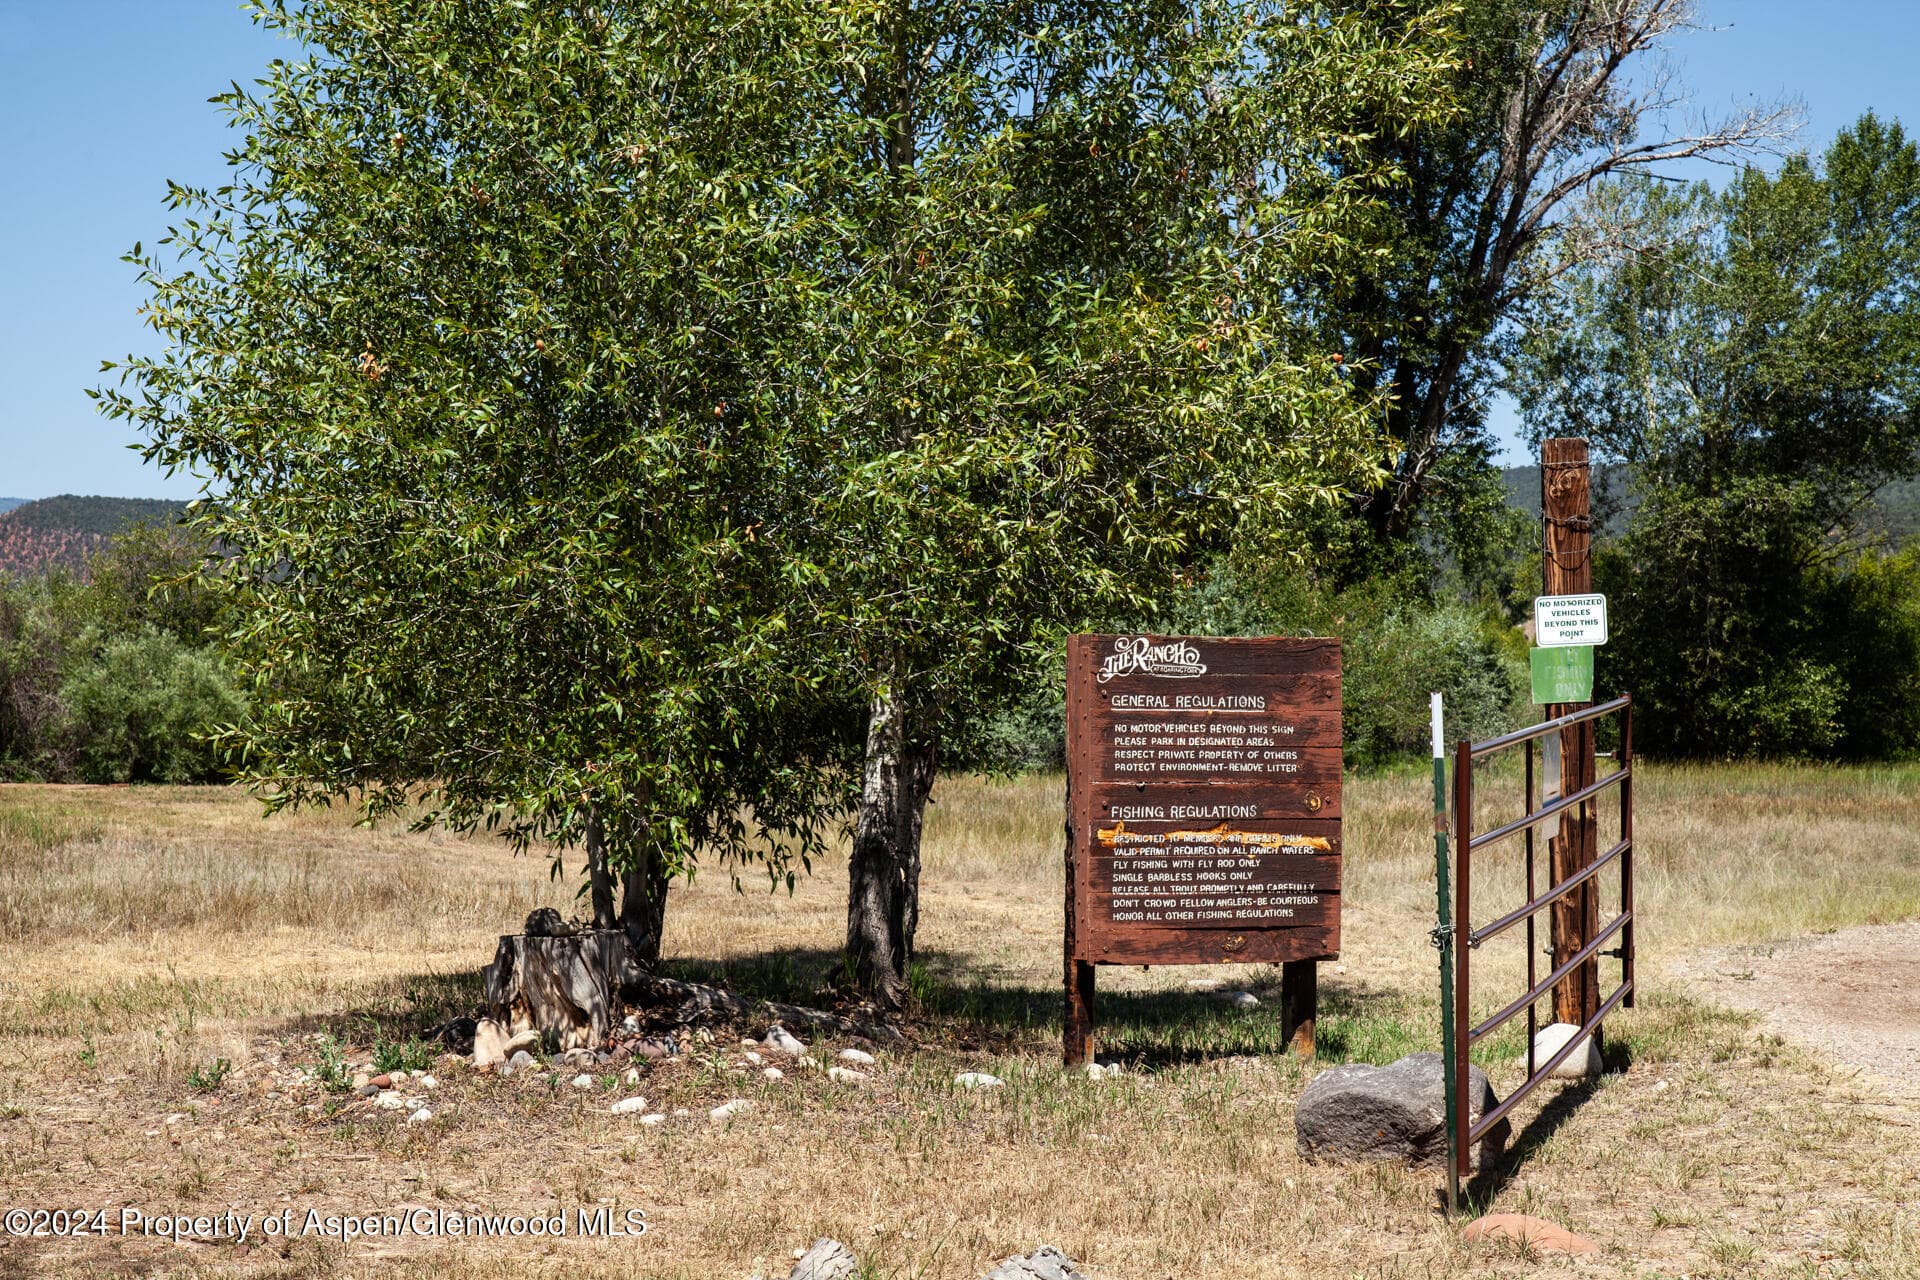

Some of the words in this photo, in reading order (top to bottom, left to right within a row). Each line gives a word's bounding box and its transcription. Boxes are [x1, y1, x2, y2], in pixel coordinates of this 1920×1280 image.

[1097, 649, 1133, 683] THE
[1112, 695, 1169, 707] GENERAL
[1176, 695, 1265, 708] REGULATIONS
[1115, 724, 1127, 732] NO
[1131, 724, 1160, 732] MOTOR
[1164, 724, 1206, 733] VEHICLES
[1210, 724, 1246, 733] BEYOND
[1249, 725, 1268, 734] THIS
[1272, 725, 1294, 734] SIGN
[1115, 737, 1147, 745] PLEASE
[1152, 737, 1173, 745] PARK
[1177, 737, 1185, 745] IN
[1189, 737, 1243, 746] DESIGNATED
[1246, 738, 1274, 746] AREAS
[1115, 750, 1155, 758] RESPECT
[1158, 750, 1195, 759] PRIVATE
[1199, 750, 1244, 759] PROPERTY
[1248, 750, 1260, 759] OF
[1264, 750, 1297, 760] OTHERS
[1115, 763, 1155, 771] PROTECT
[1268, 763, 1297, 772] LITTER
[1111, 806, 1164, 818] FISHING
[1171, 805, 1257, 818] REGULATIONS
[1173, 846, 1215, 855] REQUIRED
[1217, 846, 1229, 855] ON
[1233, 846, 1247, 855] ALL
[1250, 846, 1278, 855] RANCH
[1281, 846, 1314, 855] WATERS
[1114, 860, 1128, 869] FLY
[1133, 860, 1167, 869] FISHING
[1173, 860, 1194, 868] WITH
[1198, 860, 1214, 868] FLY
[1217, 859, 1235, 868] ROD
[1239, 859, 1261, 867] ONLY
[1113, 873, 1143, 881] SINGLE
[1148, 872, 1192, 881] BARBLESS
[1196, 872, 1226, 881] HOOKS
[1230, 872, 1252, 880] ONLY
[1113, 886, 1150, 894] RELEASE
[1153, 886, 1166, 894] ALL
[1170, 885, 1198, 894] TROUT
[1200, 885, 1244, 893] PROMPTLY
[1247, 884, 1263, 892] AND
[1113, 898, 1139, 907] DON'T
[1144, 898, 1176, 907] CROWD
[1181, 898, 1215, 907] FELLOW
[1270, 896, 1318, 905] COURTEOUS
[1113, 912, 1143, 920] HONOR
[1147, 912, 1162, 920] ALL
[1166, 911, 1194, 920] OTHER
[1197, 910, 1233, 920] FISHING
[1236, 909, 1294, 918] REGULATIONS
